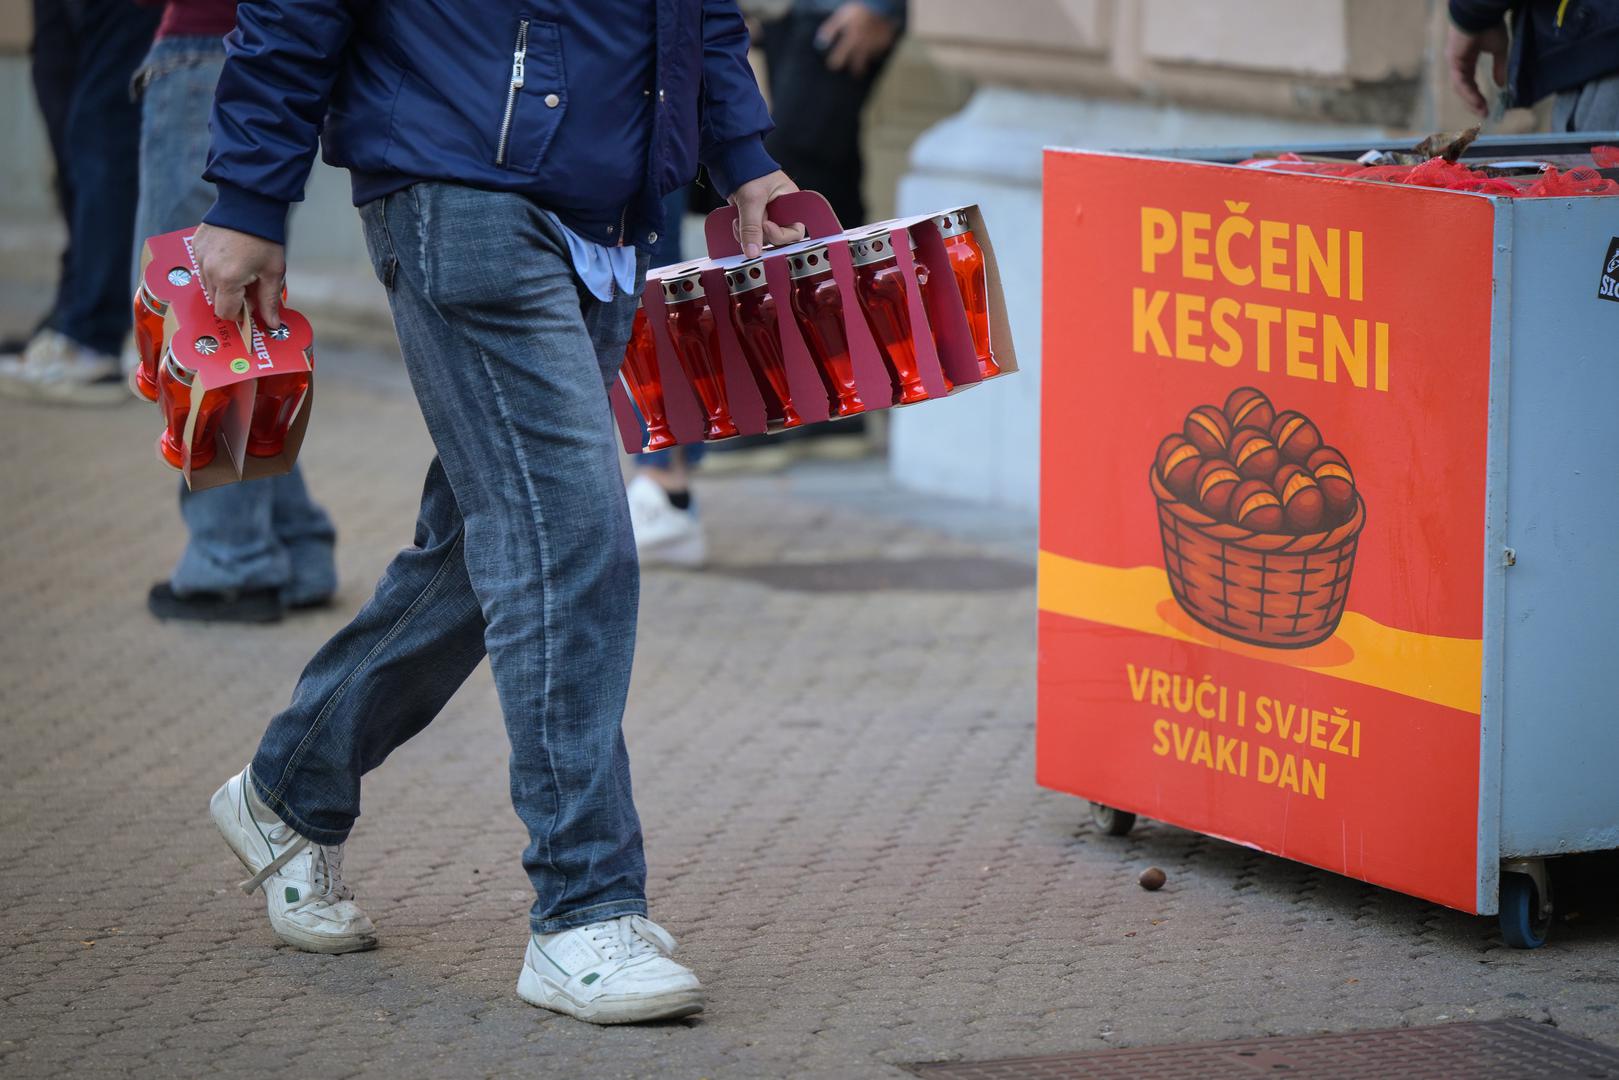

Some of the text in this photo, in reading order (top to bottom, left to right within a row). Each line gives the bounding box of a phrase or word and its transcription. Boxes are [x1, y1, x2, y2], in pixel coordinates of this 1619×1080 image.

[1140, 199, 1364, 302] PEČENI
[1132, 287, 1389, 392] KESTENI
[1126, 663, 1361, 758] VRUĆI I SVJEŽI
[1152, 718, 1326, 800] SVAKI DAN
